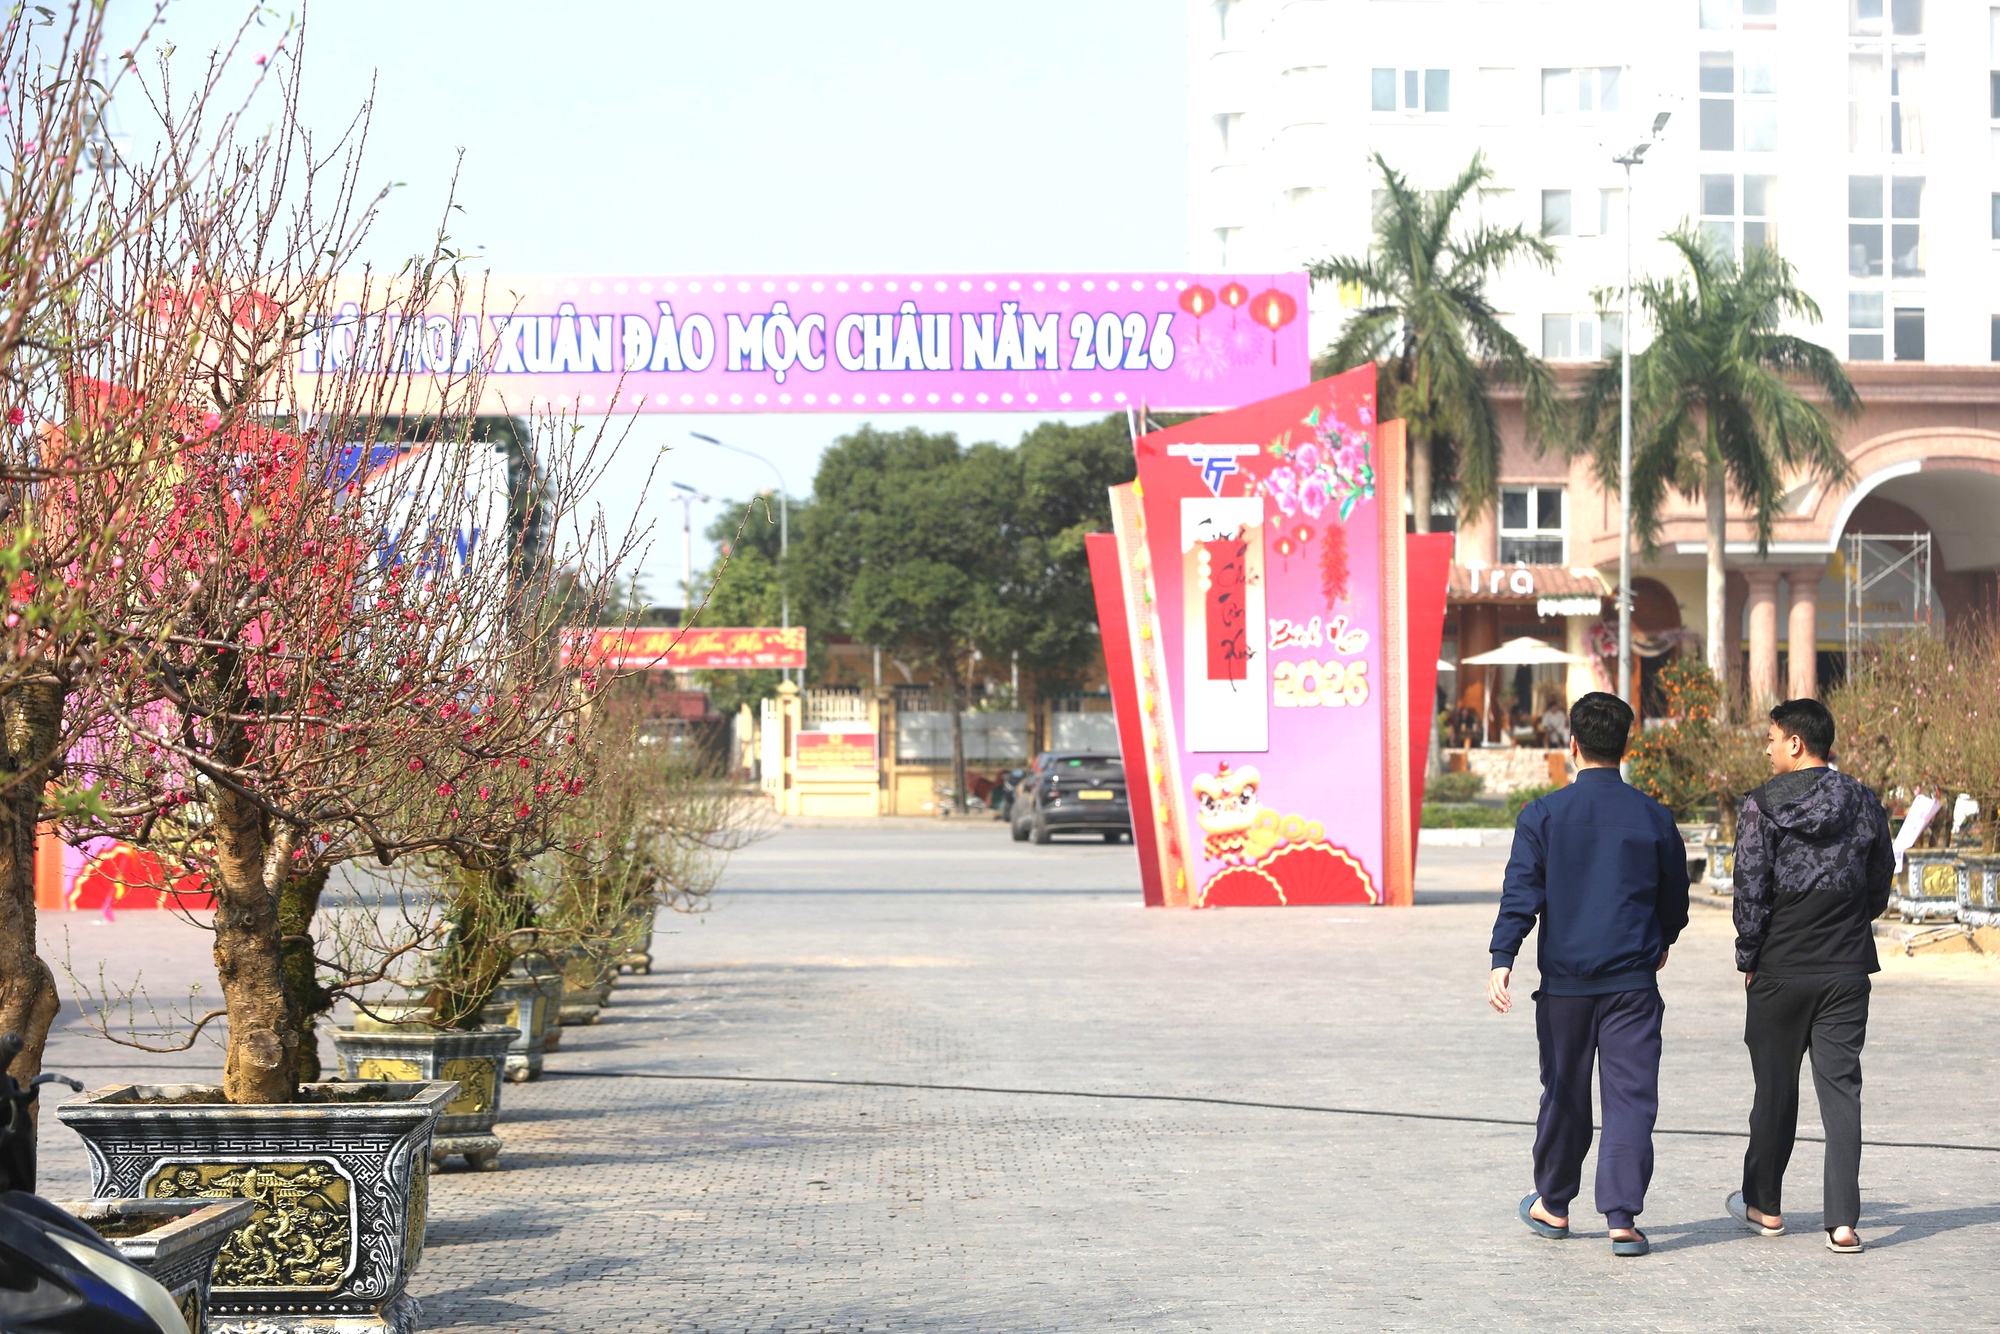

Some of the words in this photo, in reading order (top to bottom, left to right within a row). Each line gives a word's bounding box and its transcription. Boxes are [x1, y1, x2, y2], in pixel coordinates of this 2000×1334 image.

[300, 302, 382, 384] HỘI
[390, 315, 486, 374] HOA
[490, 302, 614, 374] XUÂN
[621, 301, 716, 374] ĐÀO
[724, 301, 826, 384] MỘC
[834, 300, 953, 372] CHÂU
[959, 301, 1061, 371] NĂM
[1068, 311, 1176, 372] 2026
[1464, 560, 1534, 594] Trà
[1273, 658, 1371, 708] 2026
